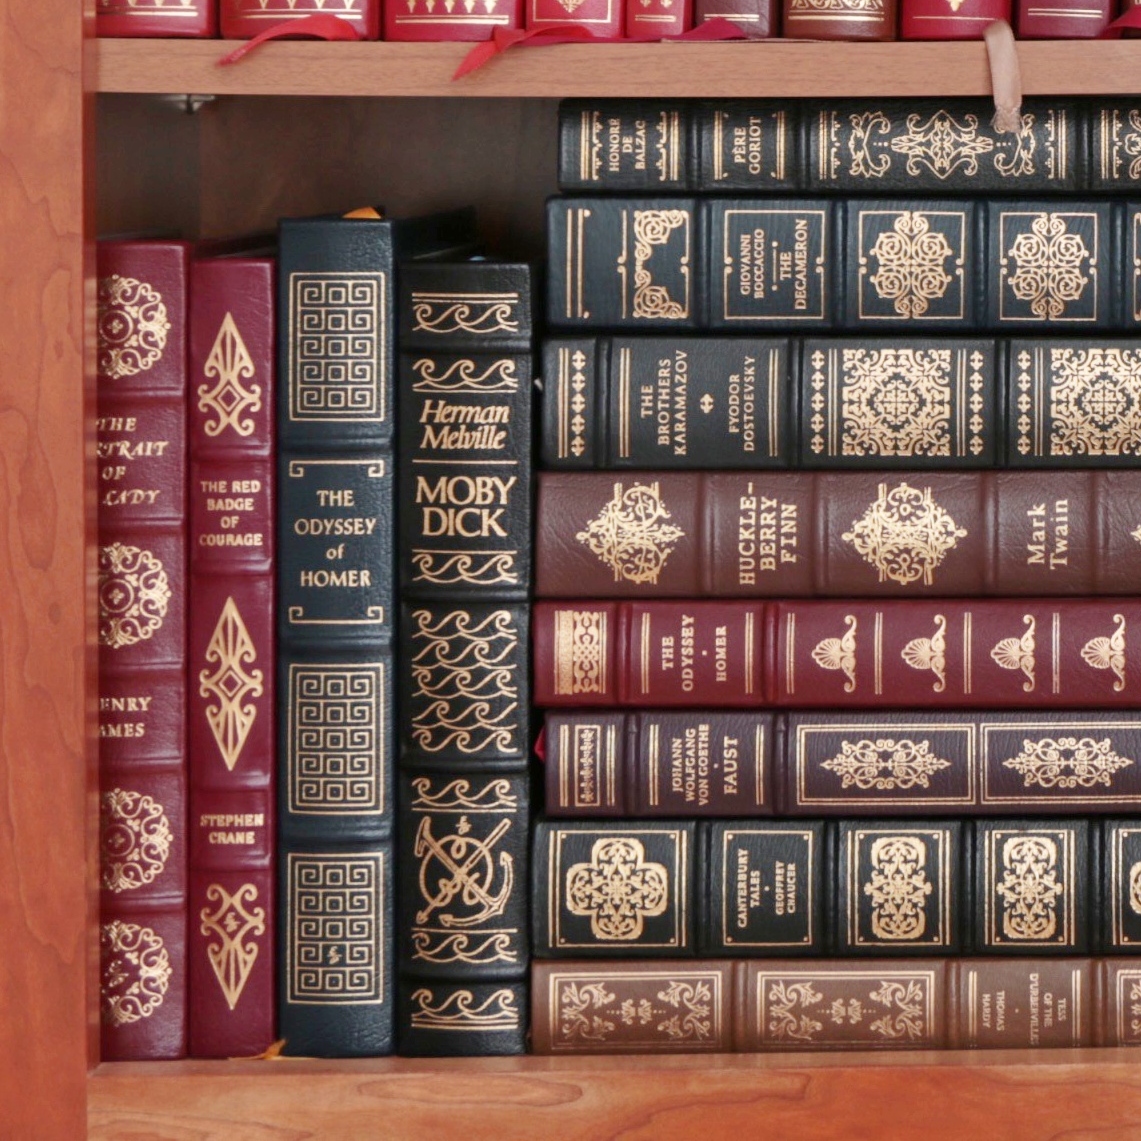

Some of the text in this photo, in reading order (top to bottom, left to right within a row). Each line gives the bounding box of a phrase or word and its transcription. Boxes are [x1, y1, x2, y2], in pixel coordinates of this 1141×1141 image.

[740, 234, 751, 295] GIOVANNI
[754, 229, 764, 299] BOCCACCIO
[780, 252, 791, 280] THE
[794, 219, 808, 310] DECAMERON
[420, 399, 510, 423] Herman
[641, 385, 653, 418] THE
[658, 358, 671, 445] BROTHERS
[674, 350, 688, 455] KARAMAZOV
[728, 374, 740, 433] FYODOR
[743, 356, 755, 451] DOSTOEVSKY
[420, 425, 506, 449] Melville
[200, 481, 260, 492] THE RED
[316, 490, 354, 506] THE
[415, 476, 517, 503] MOBY
[207, 499, 254, 511] BADGE
[221, 516, 240, 528] OF
[294, 518, 376, 535] ODYSSEY
[422, 508, 508, 537] DICK
[739, 482, 756, 585] HUCKLE-
[760, 497, 777, 571] BERRY
[781, 504, 796, 563] FINN
[1027, 503, 1046, 565] Mark
[1050, 499, 1068, 570] Twain
[200, 533, 263, 546] COURAGE
[326, 544, 345, 559] of
[300, 570, 371, 587] HOMER
[662, 636, 674, 670] THE
[682, 615, 694, 691] ODYSSEY
[716, 626, 727, 681] HOMER
[724, 737, 738, 795] FAUST
[200, 814, 264, 827] STEPHEN
[209, 832, 255, 844] CRANE
